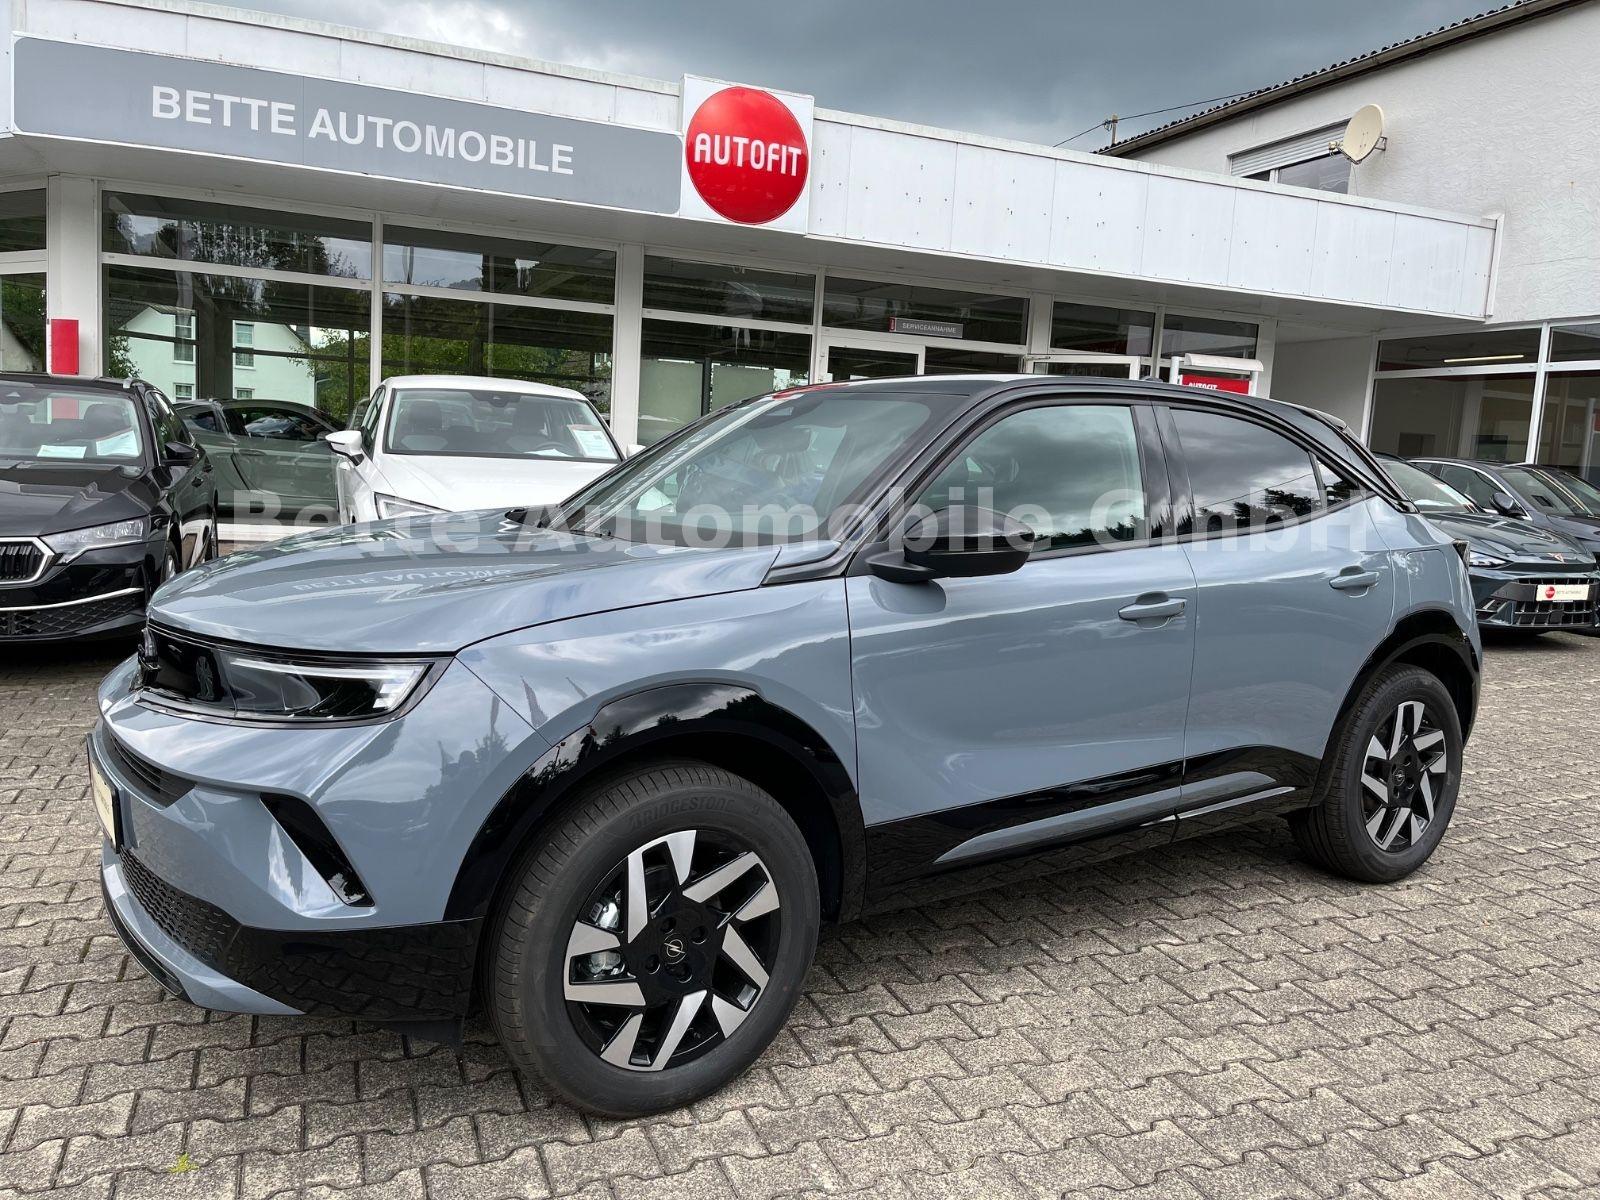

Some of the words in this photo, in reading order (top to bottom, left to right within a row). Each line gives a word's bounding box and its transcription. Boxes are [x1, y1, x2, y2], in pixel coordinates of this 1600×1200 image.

[152, 85, 297, 136] BETTE
[308, 108, 574, 175] AUTOMOBILE
[694, 132, 802, 177] AUTOFIT
[902, 322, 957, 334] SERVICEANNAHME
